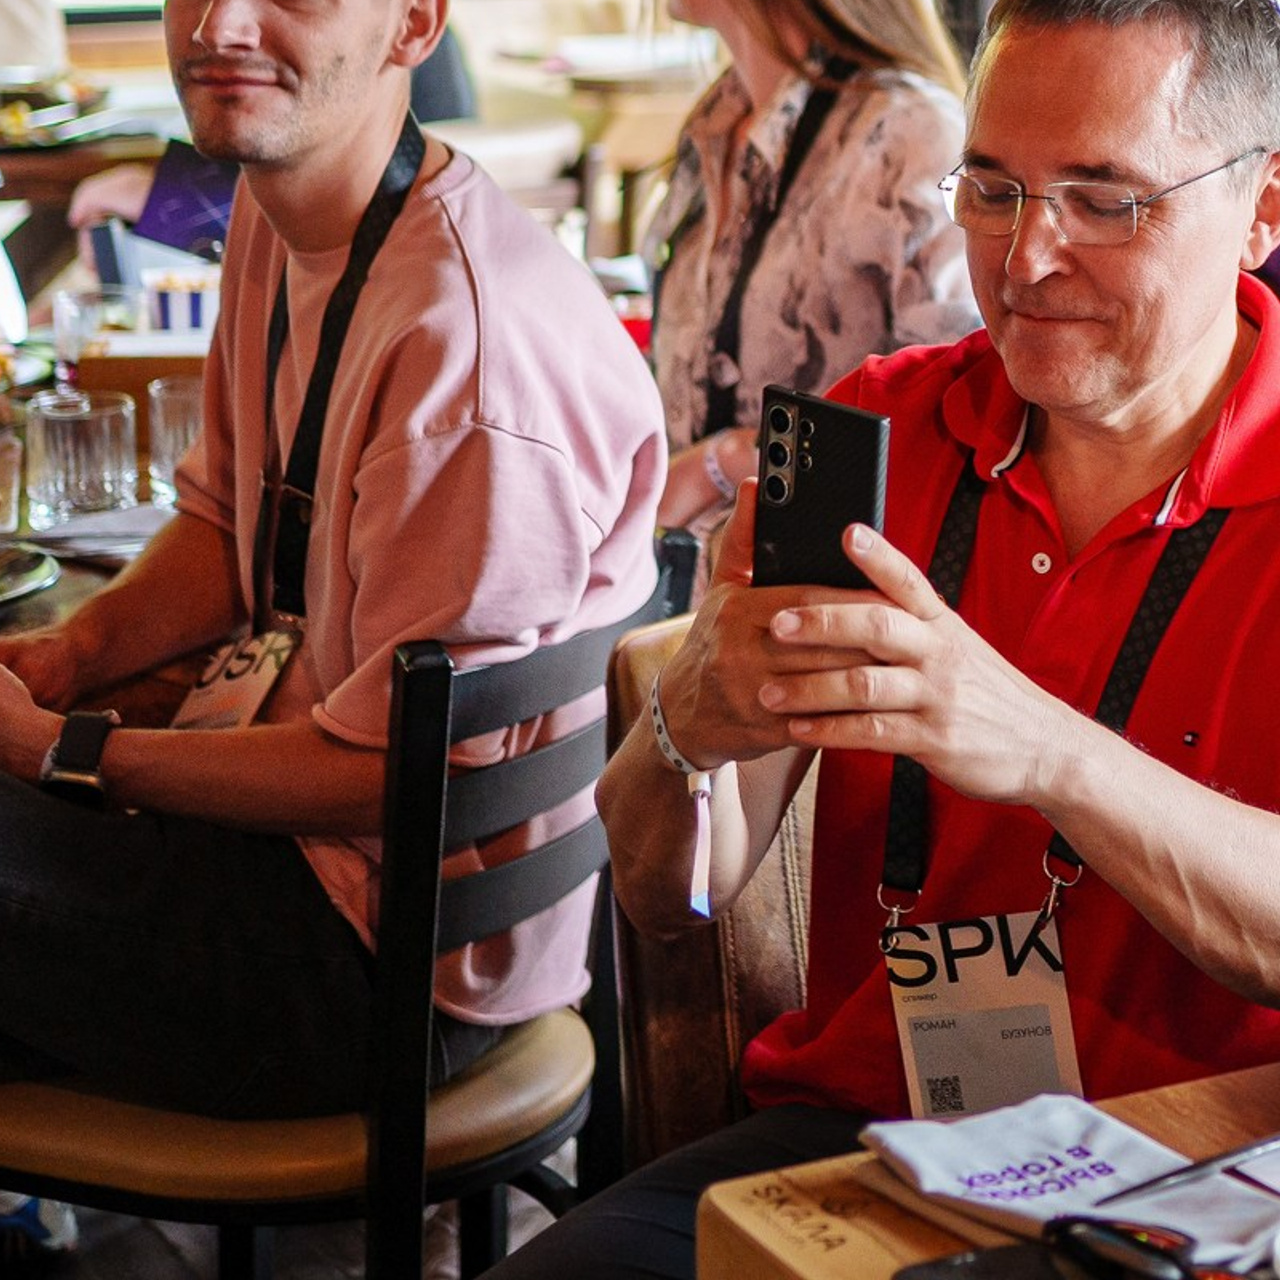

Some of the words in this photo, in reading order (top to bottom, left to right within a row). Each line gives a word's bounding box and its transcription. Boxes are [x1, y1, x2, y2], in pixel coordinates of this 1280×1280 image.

[880, 910, 1066, 988] SPK
[913, 1019, 957, 1033] РОМАН
[1001, 1025, 1053, 1040] БУЗУНОВ
